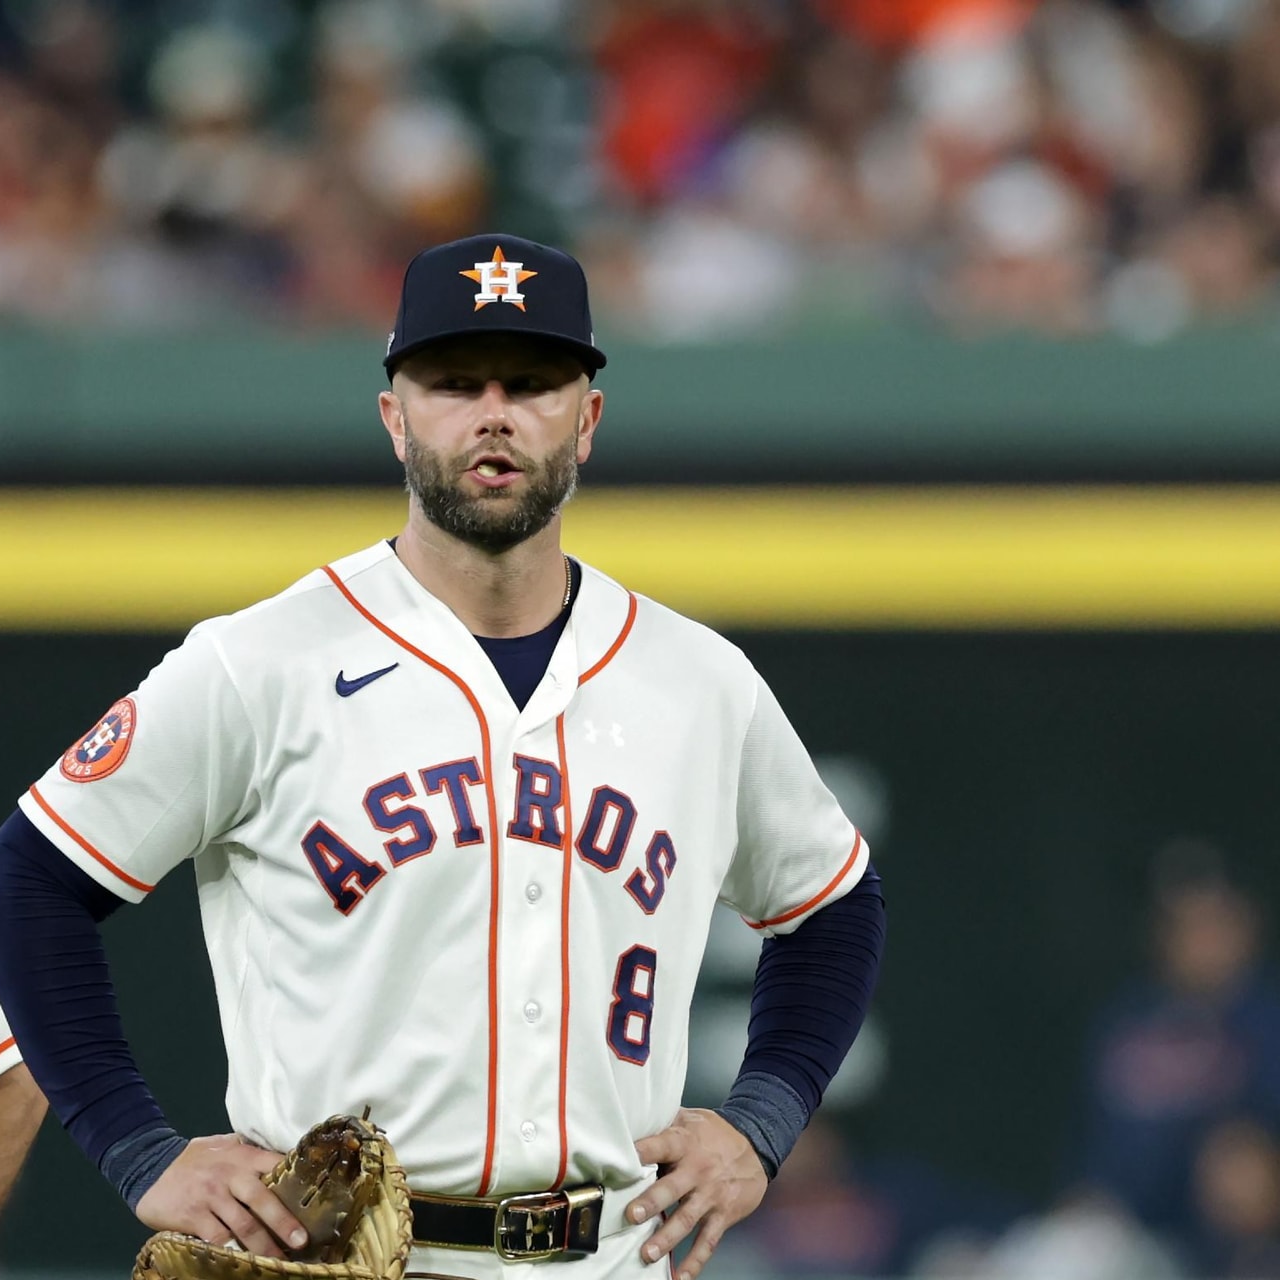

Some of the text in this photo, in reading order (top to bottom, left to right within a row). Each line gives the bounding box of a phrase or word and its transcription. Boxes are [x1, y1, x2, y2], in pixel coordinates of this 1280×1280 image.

[474, 261, 525, 303] H
[300, 752, 677, 917] ASTROS
[606, 943, 657, 1067] 8
